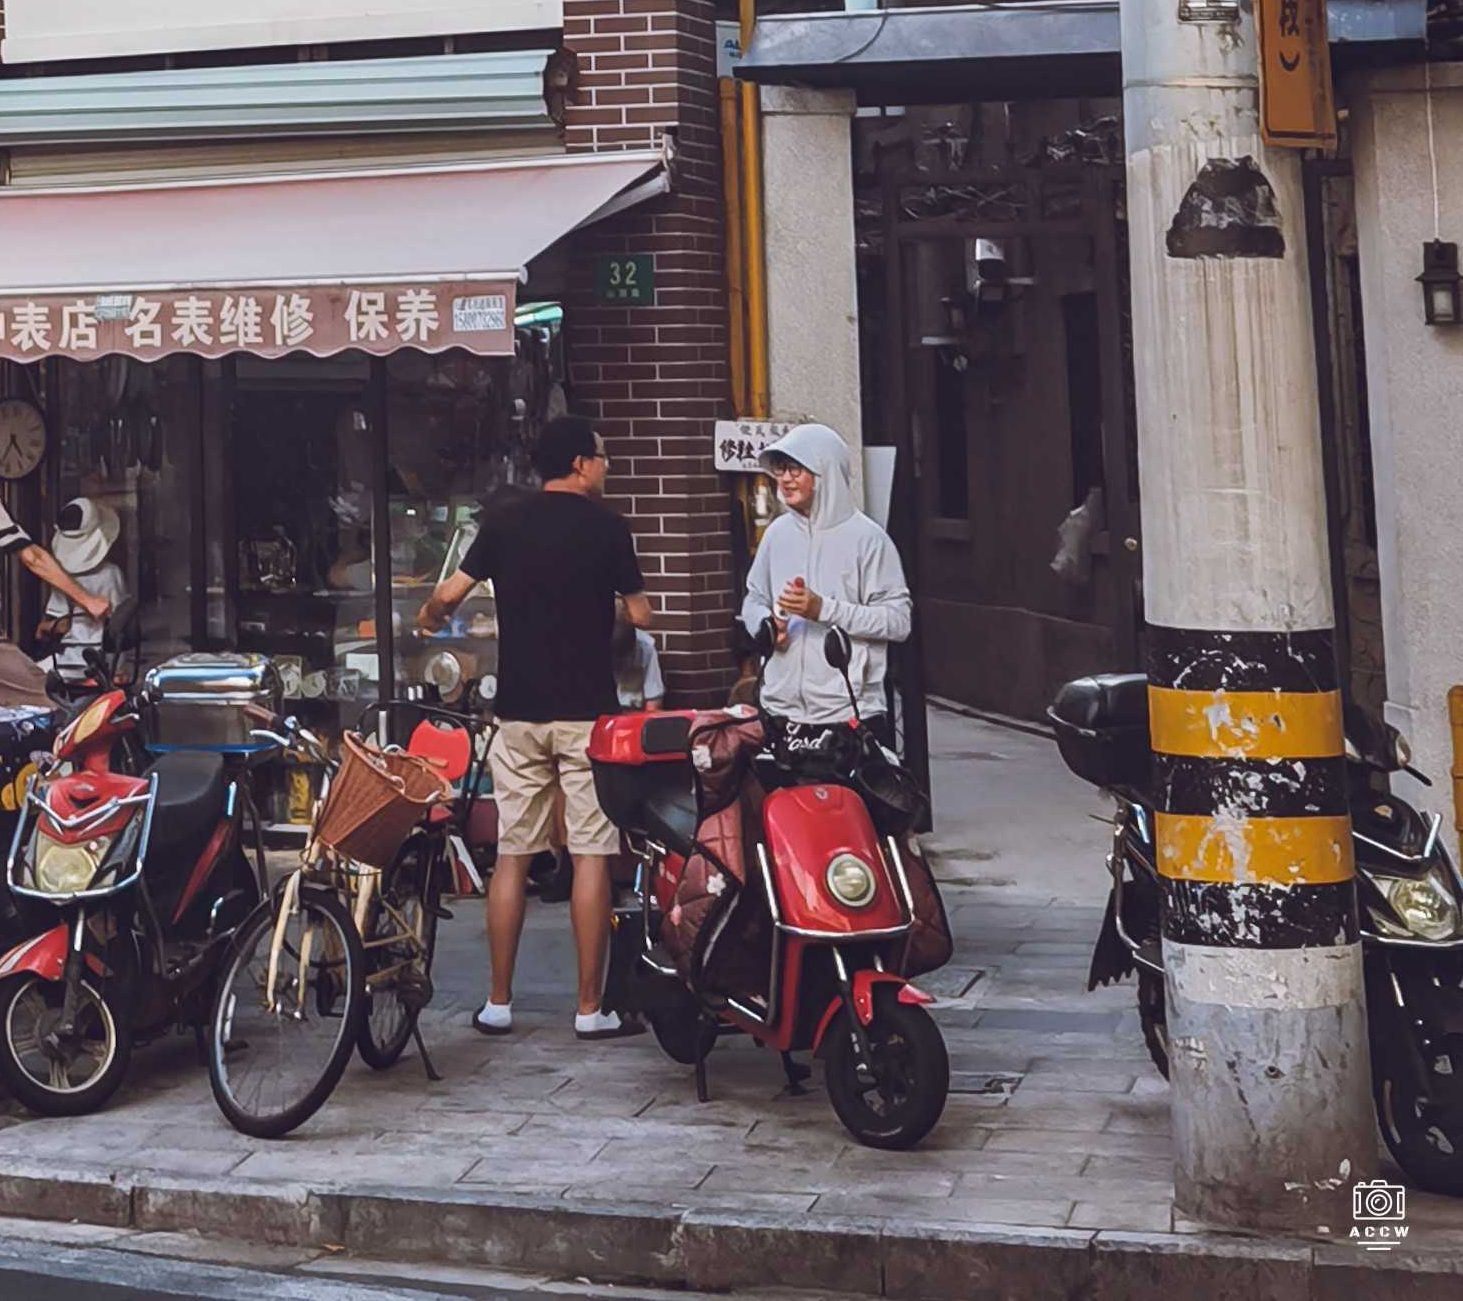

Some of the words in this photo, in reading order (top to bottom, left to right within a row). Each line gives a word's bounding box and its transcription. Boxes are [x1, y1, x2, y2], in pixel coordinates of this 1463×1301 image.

[610, 261, 637, 285] 32
[124, 293, 314, 347] 名表维修
[344, 288, 440, 342] 保养
